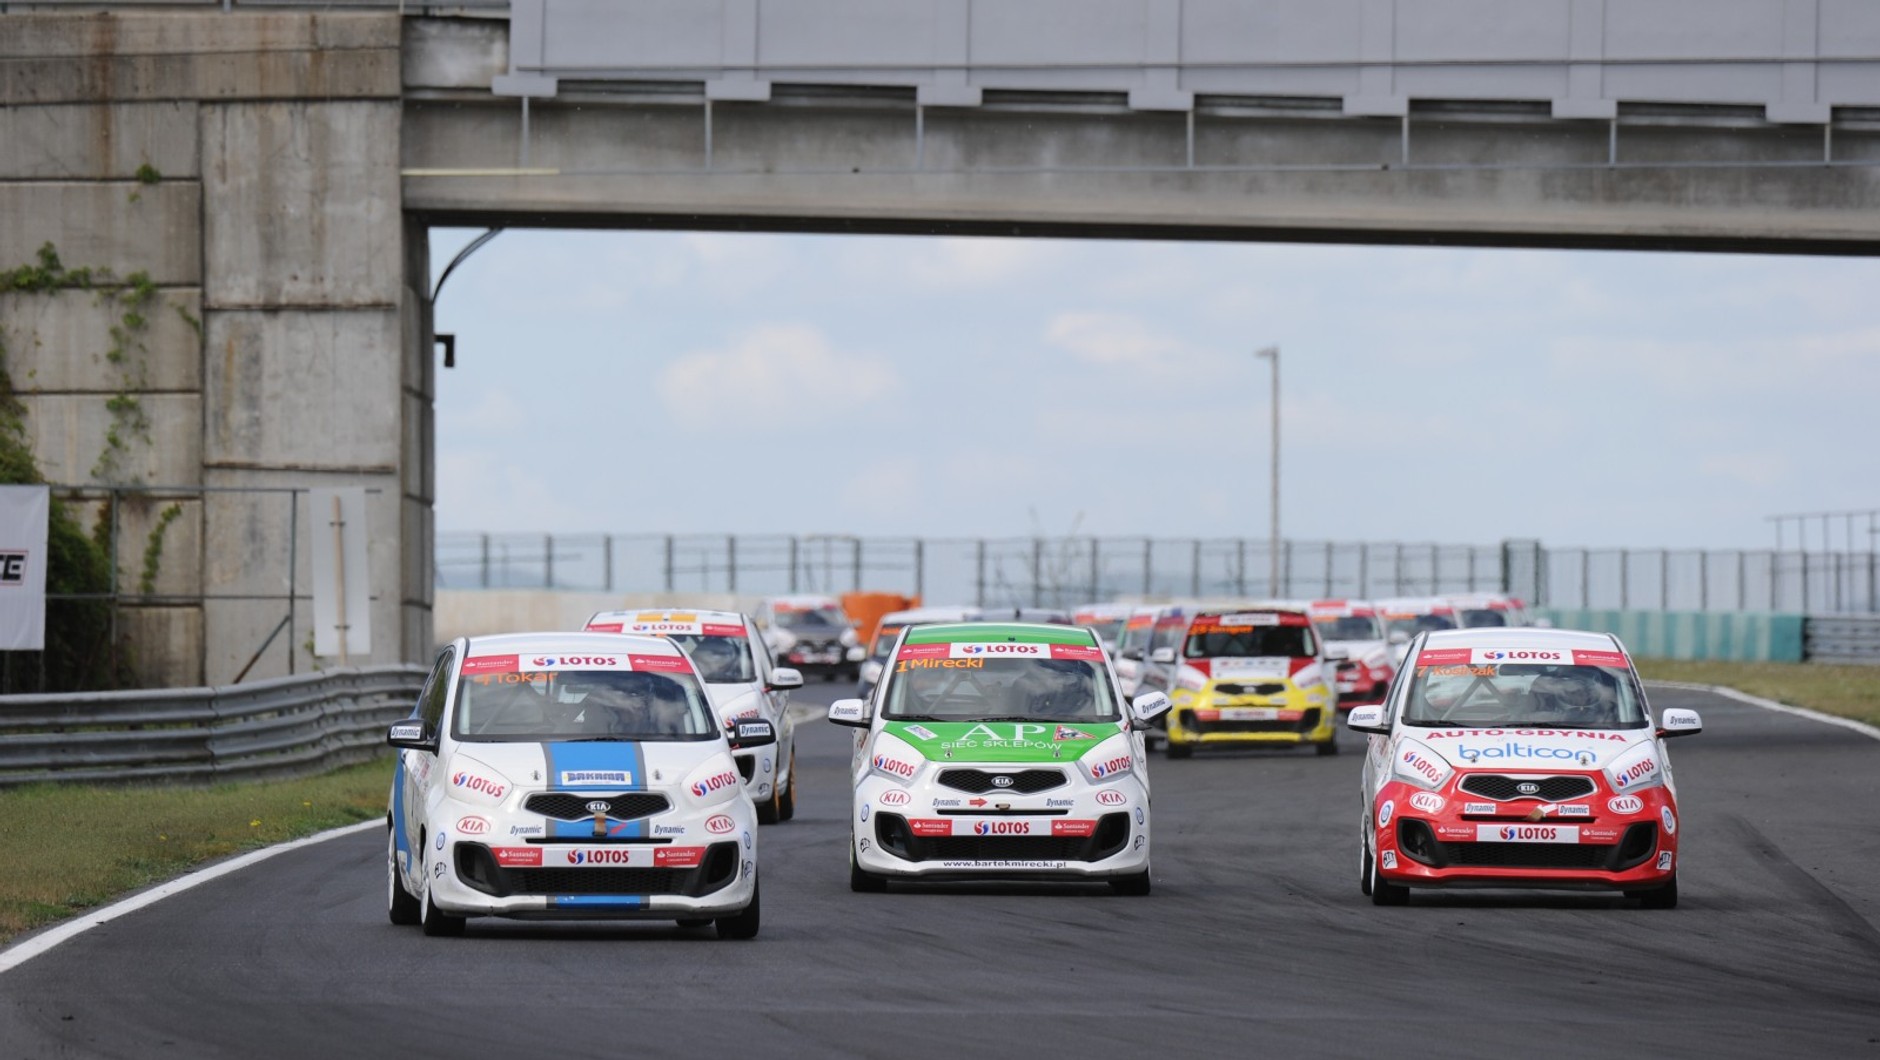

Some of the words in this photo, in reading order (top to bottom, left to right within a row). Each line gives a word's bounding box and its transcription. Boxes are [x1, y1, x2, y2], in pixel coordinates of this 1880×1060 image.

[0, 554, 25, 580] E
[987, 645, 1038, 653] LOTOS
[560, 657, 617, 666] LOTOS
[1508, 651, 1560, 660] LOTOS
[896, 660, 908, 672] 1
[910, 657, 984, 669] Mirecki
[1142, 697, 1165, 714] Dynamic
[1670, 716, 1696, 725] Dynamic
[391, 727, 420, 737] Dynamic
[741, 725, 769, 735] Dynamic
[956, 724, 1047, 740] AP
[1426, 730, 1627, 741] AUTO-GDYNIA
[1459, 742, 1596, 762] balticon
[883, 758, 914, 777] LOTOS
[1104, 756, 1131, 773] LOTOS
[1412, 756, 1443, 782] LOTOS
[1626, 758, 1654, 780] LOTOS
[466, 775, 505, 798] LOTOS
[705, 771, 737, 791] LOTOS
[993, 777, 1011, 785] KIA
[1519, 784, 1537, 792] KIA
[882, 792, 906, 805] KIA
[932, 797, 961, 807] Dynamic
[1046, 798, 1074, 807] Dynamic
[1099, 792, 1124, 804] KIA
[1414, 793, 1439, 808] KIA
[588, 802, 608, 811] KIA
[1466, 803, 1495, 813] Dynamic
[1560, 805, 1588, 814] Dynamic
[1613, 798, 1639, 811] KIA
[460, 818, 485, 832] KIA
[510, 825, 542, 835] Dynamic
[654, 825, 685, 834] Dynamic
[708, 817, 732, 832] KIA
[991, 822, 1030, 834] LOTOS
[1518, 828, 1557, 840] LOTOS
[508, 850, 538, 858] Santander
[587, 850, 629, 864] LOTOS
[943, 860, 1067, 869] www.bartekmirecki.pl
